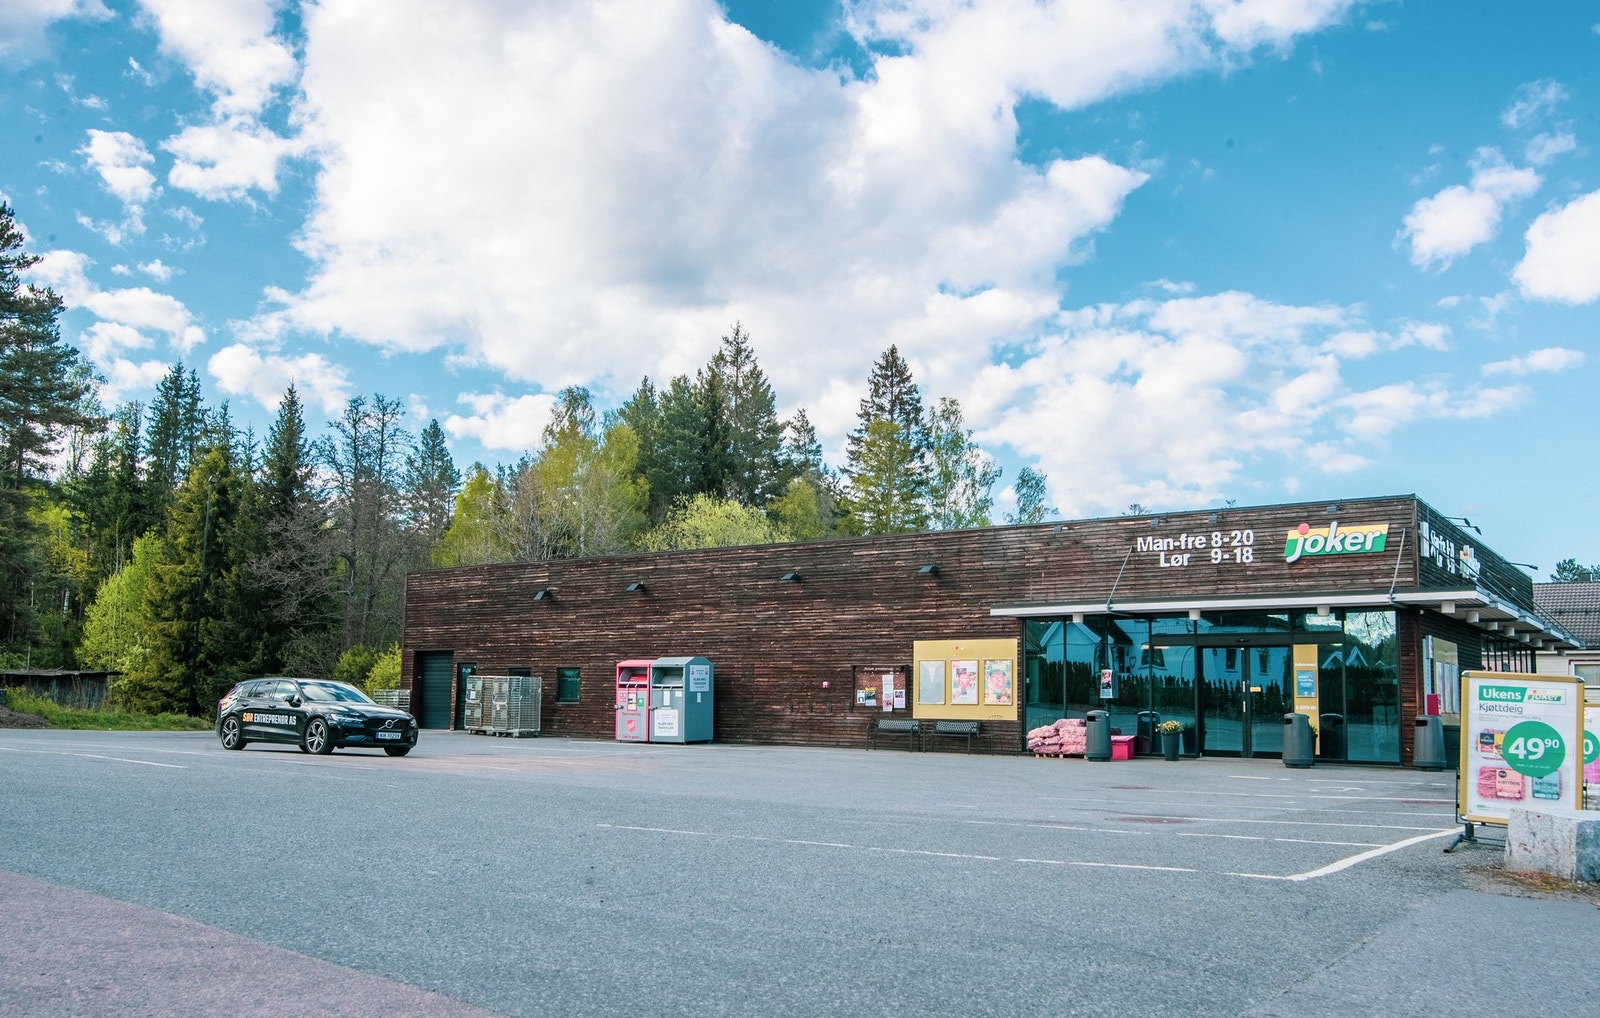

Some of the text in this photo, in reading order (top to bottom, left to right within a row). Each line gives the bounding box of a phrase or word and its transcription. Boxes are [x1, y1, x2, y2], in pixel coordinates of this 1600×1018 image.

[1137, 529, 1254, 552] Man-fre 8-20
[1286, 521, 1381, 563] joker
[1160, 547, 1254, 567] Lør 9-18
[1483, 688, 1521, 700] Ukens
[1479, 703, 1523, 715] Kjøttdeig
[288, 715, 297, 725] AS
